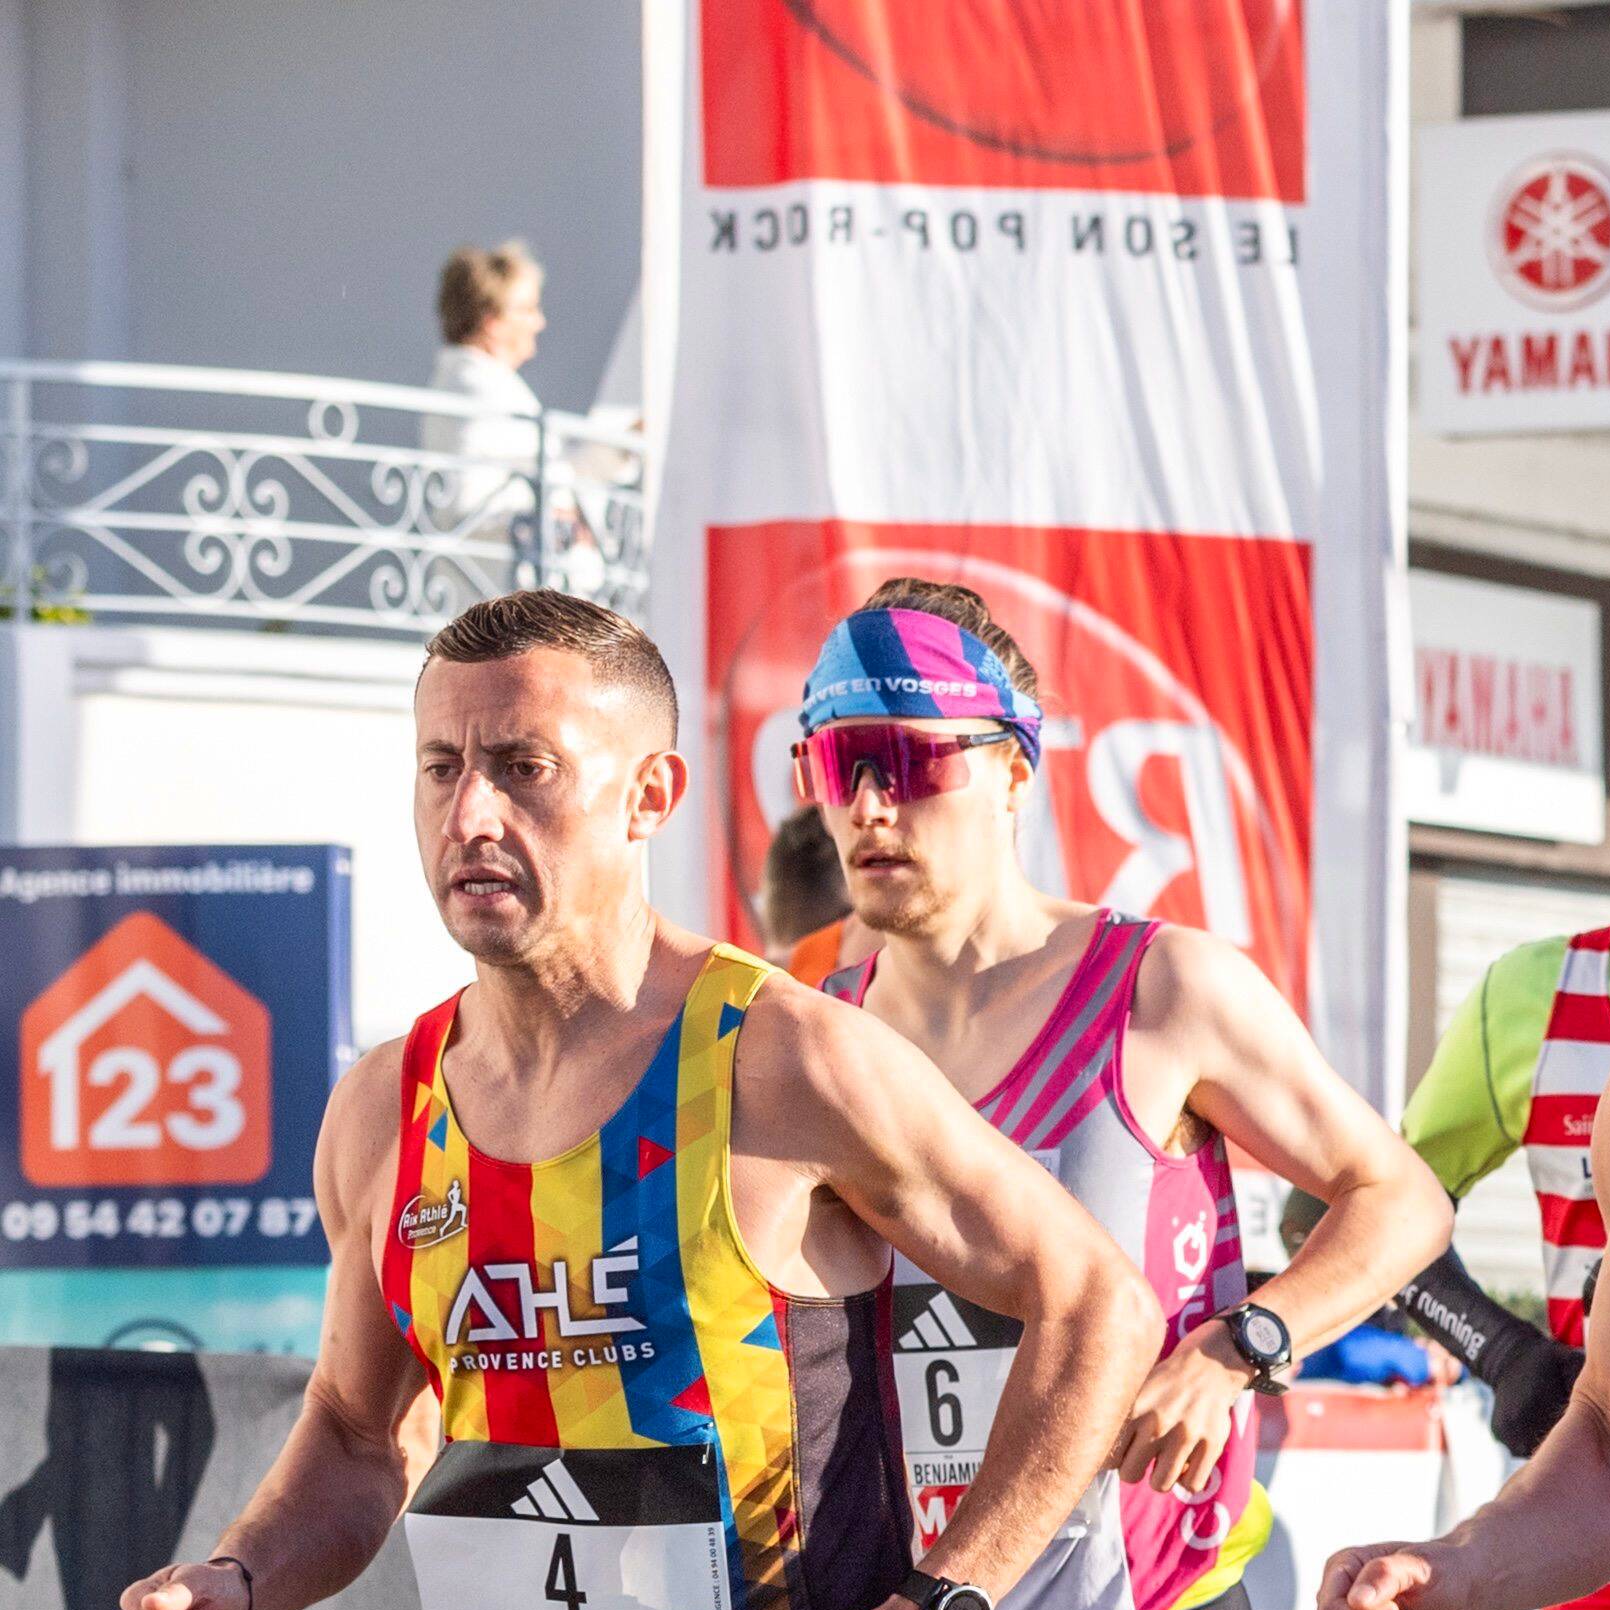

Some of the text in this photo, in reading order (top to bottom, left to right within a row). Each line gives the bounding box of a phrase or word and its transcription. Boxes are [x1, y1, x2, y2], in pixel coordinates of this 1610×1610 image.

[884, 677, 977, 698] VOSGES
[1413, 648, 1580, 768] YAMAHA
[38, 1015, 247, 1152] 123
[4, 1198, 319, 1240] 09 54 42 07 87
[420, 1203, 448, 1224] Athlé
[1417, 1291, 1487, 1361] running
[449, 1342, 656, 1373] PROVENCE CLUBS
[924, 1358, 963, 1448] 6
